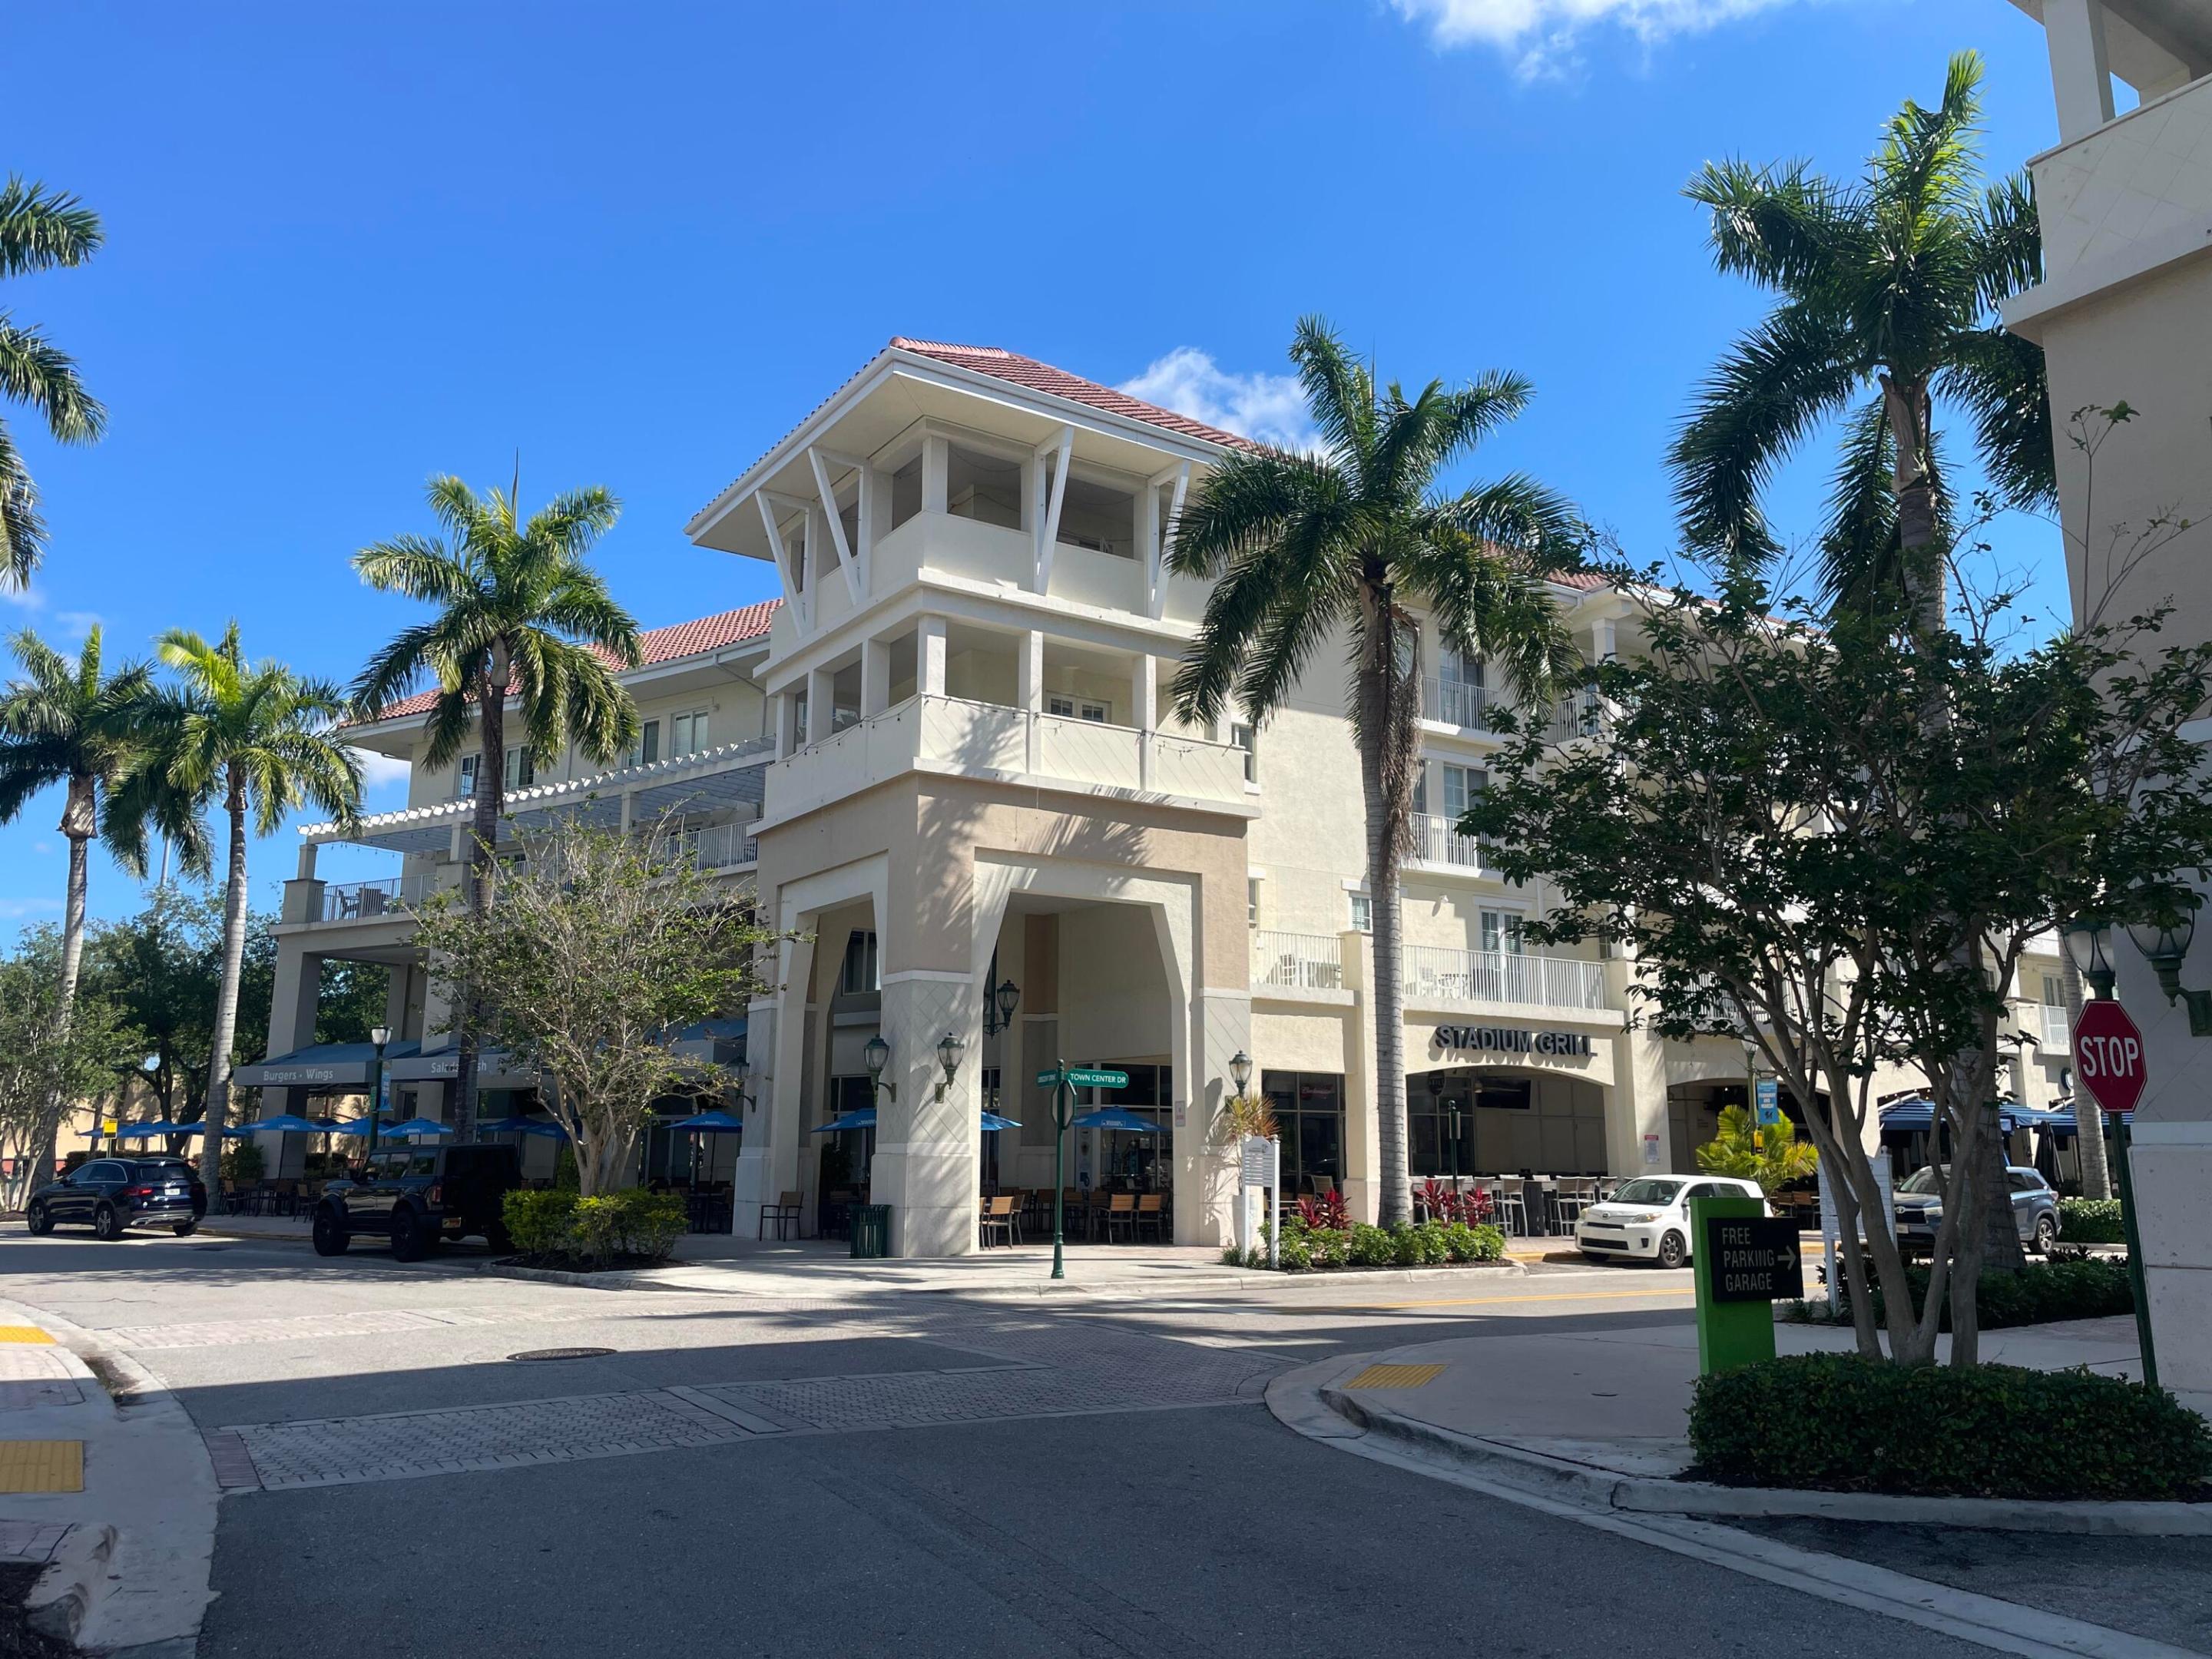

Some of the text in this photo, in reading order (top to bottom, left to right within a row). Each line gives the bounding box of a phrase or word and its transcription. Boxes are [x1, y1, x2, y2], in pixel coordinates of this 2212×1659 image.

[1435, 1025, 1598, 1057] STADIUM GRILL
[2080, 1035, 2139, 1078] STOP
[263, 1068, 333, 1082] Burgers Wings
[1070, 1073, 1091, 1082] TOWN
[1091, 1075, 1116, 1083] CENTER
[1721, 1227, 1751, 1245] FREE
[1723, 1249, 1775, 1268] PARKING
[1725, 1273, 1773, 1292] GARAGE
